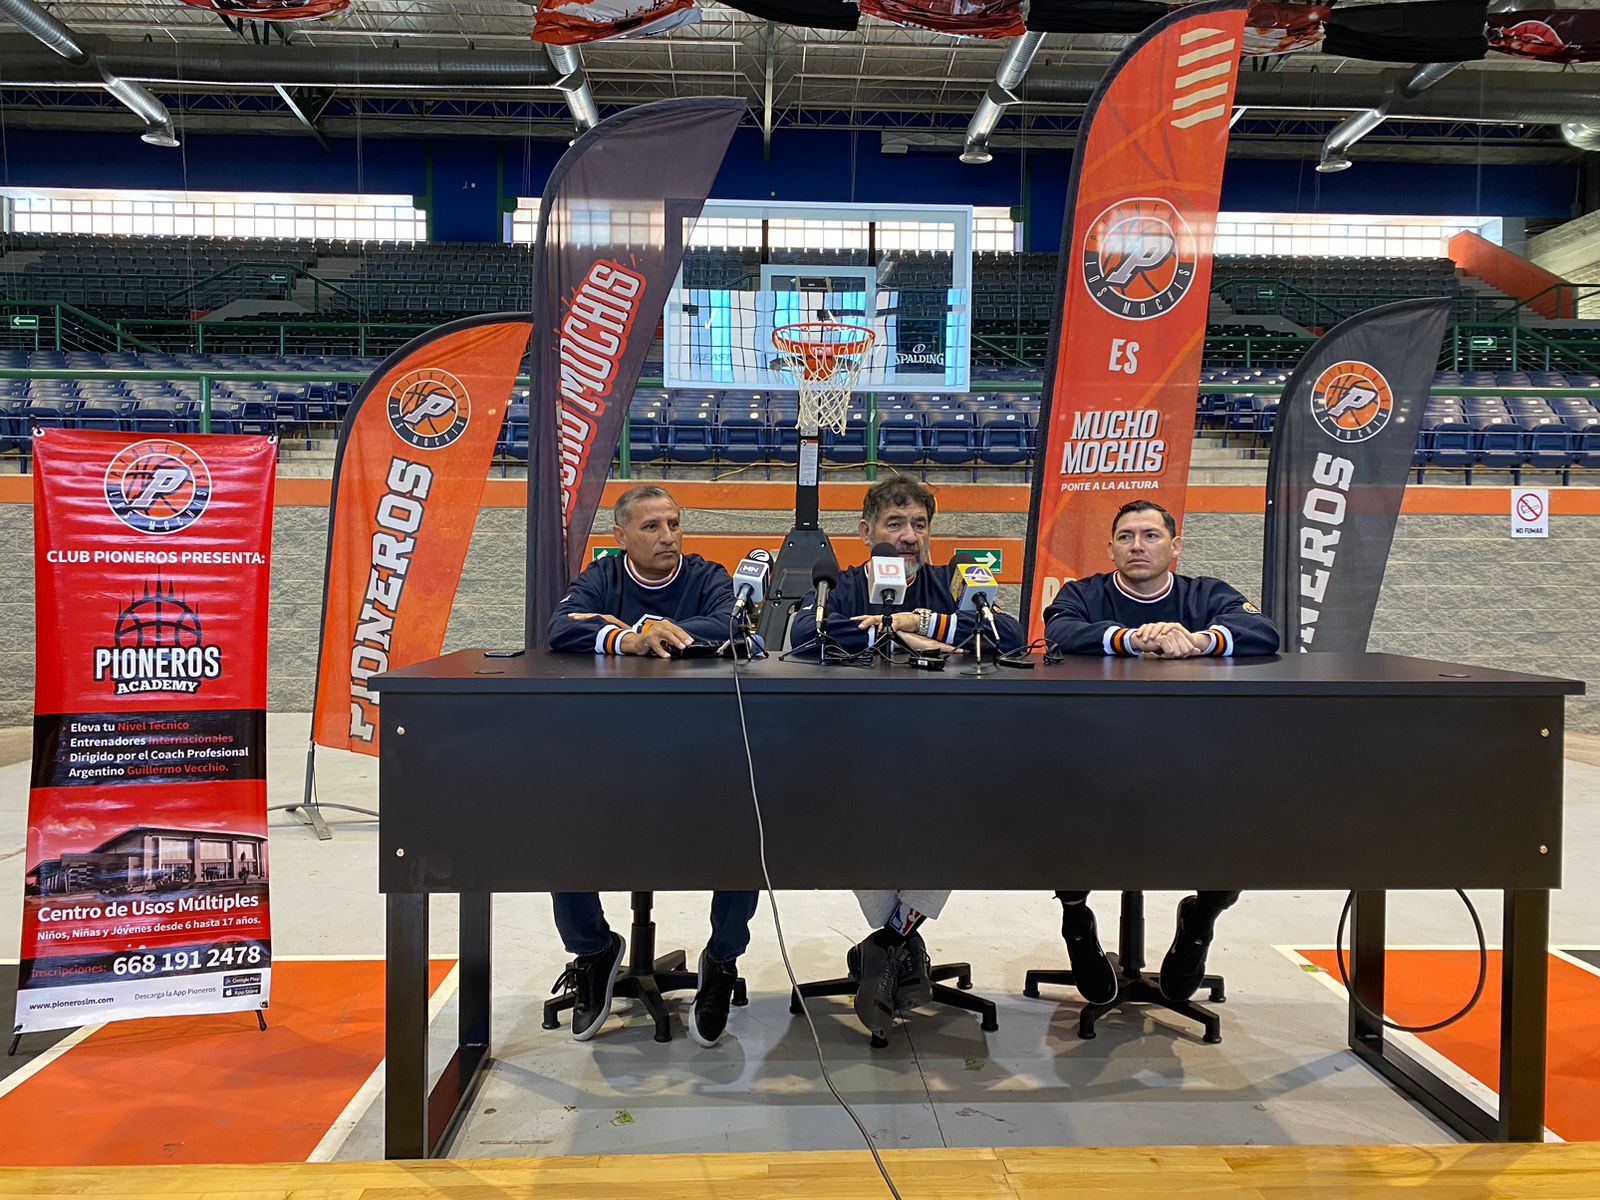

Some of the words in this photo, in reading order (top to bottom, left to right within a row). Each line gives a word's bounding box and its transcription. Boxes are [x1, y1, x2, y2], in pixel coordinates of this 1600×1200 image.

[1121, 268, 1191, 316] MOCHIS
[560, 263, 642, 413] MOCHIS
[895, 352, 944, 366] SPALDING
[1108, 338, 1140, 374] ES
[1070, 410, 1159, 440] MUCHO
[1060, 440, 1165, 474] MOCHIS
[1061, 482, 1091, 492] PONTE
[1092, 482, 1100, 491] A
[1102, 482, 1116, 490] LA
[1117, 481, 1159, 490] ALTURA
[47, 550, 90, 563] CLUB
[94, 551, 177, 564] PIONEROS
[181, 552, 265, 565] PRESENTA:
[742, 565, 760, 573] MN
[350, 456, 434, 743] PIONEROS
[95, 648, 220, 680] PIONEROS
[117, 680, 198, 694] ACADEMY
[71, 723, 100, 733] Eleva
[103, 723, 115, 732] tu
[118, 722, 146, 731] Nivel
[70, 736, 146, 748] Entrenadores
[148, 734, 234, 745] Internacionales
[70, 751, 115, 764] Dirigido
[116, 754, 136, 766] por
[138, 750, 149, 760] el
[151, 749, 185, 760] Coach
[187, 747, 249, 758] Profesional
[69, 766, 125, 779] Argentino
[127, 764, 182, 775] Guillermo
[184, 763, 229, 773] Vecchio.
[38, 904, 102, 922] Centro
[105, 902, 128, 918] de
[132, 899, 174, 916] Usos
[178, 892, 259, 913] Múltiples
[37, 929, 70, 941] Niños,
[72, 927, 101, 938] Niñas
[102, 929, 108, 938] y
[111, 924, 152, 936] Jóvenes
[154, 921, 183, 932] desde
[185, 921, 191, 929] 6
[193, 918, 220, 929] hasta
[222, 917, 233, 926] 17
[235, 916, 261, 925] años.
[32, 963, 107, 978] Inscripciones:
[113, 954, 156, 975] 668
[161, 950, 201, 971] 191
[206, 945, 261, 967] 2478
[134, 990, 165, 1001] Descarga
[166, 990, 172, 998] la
[173, 989, 186, 999] App
[187, 986, 216, 996] Pioneros
